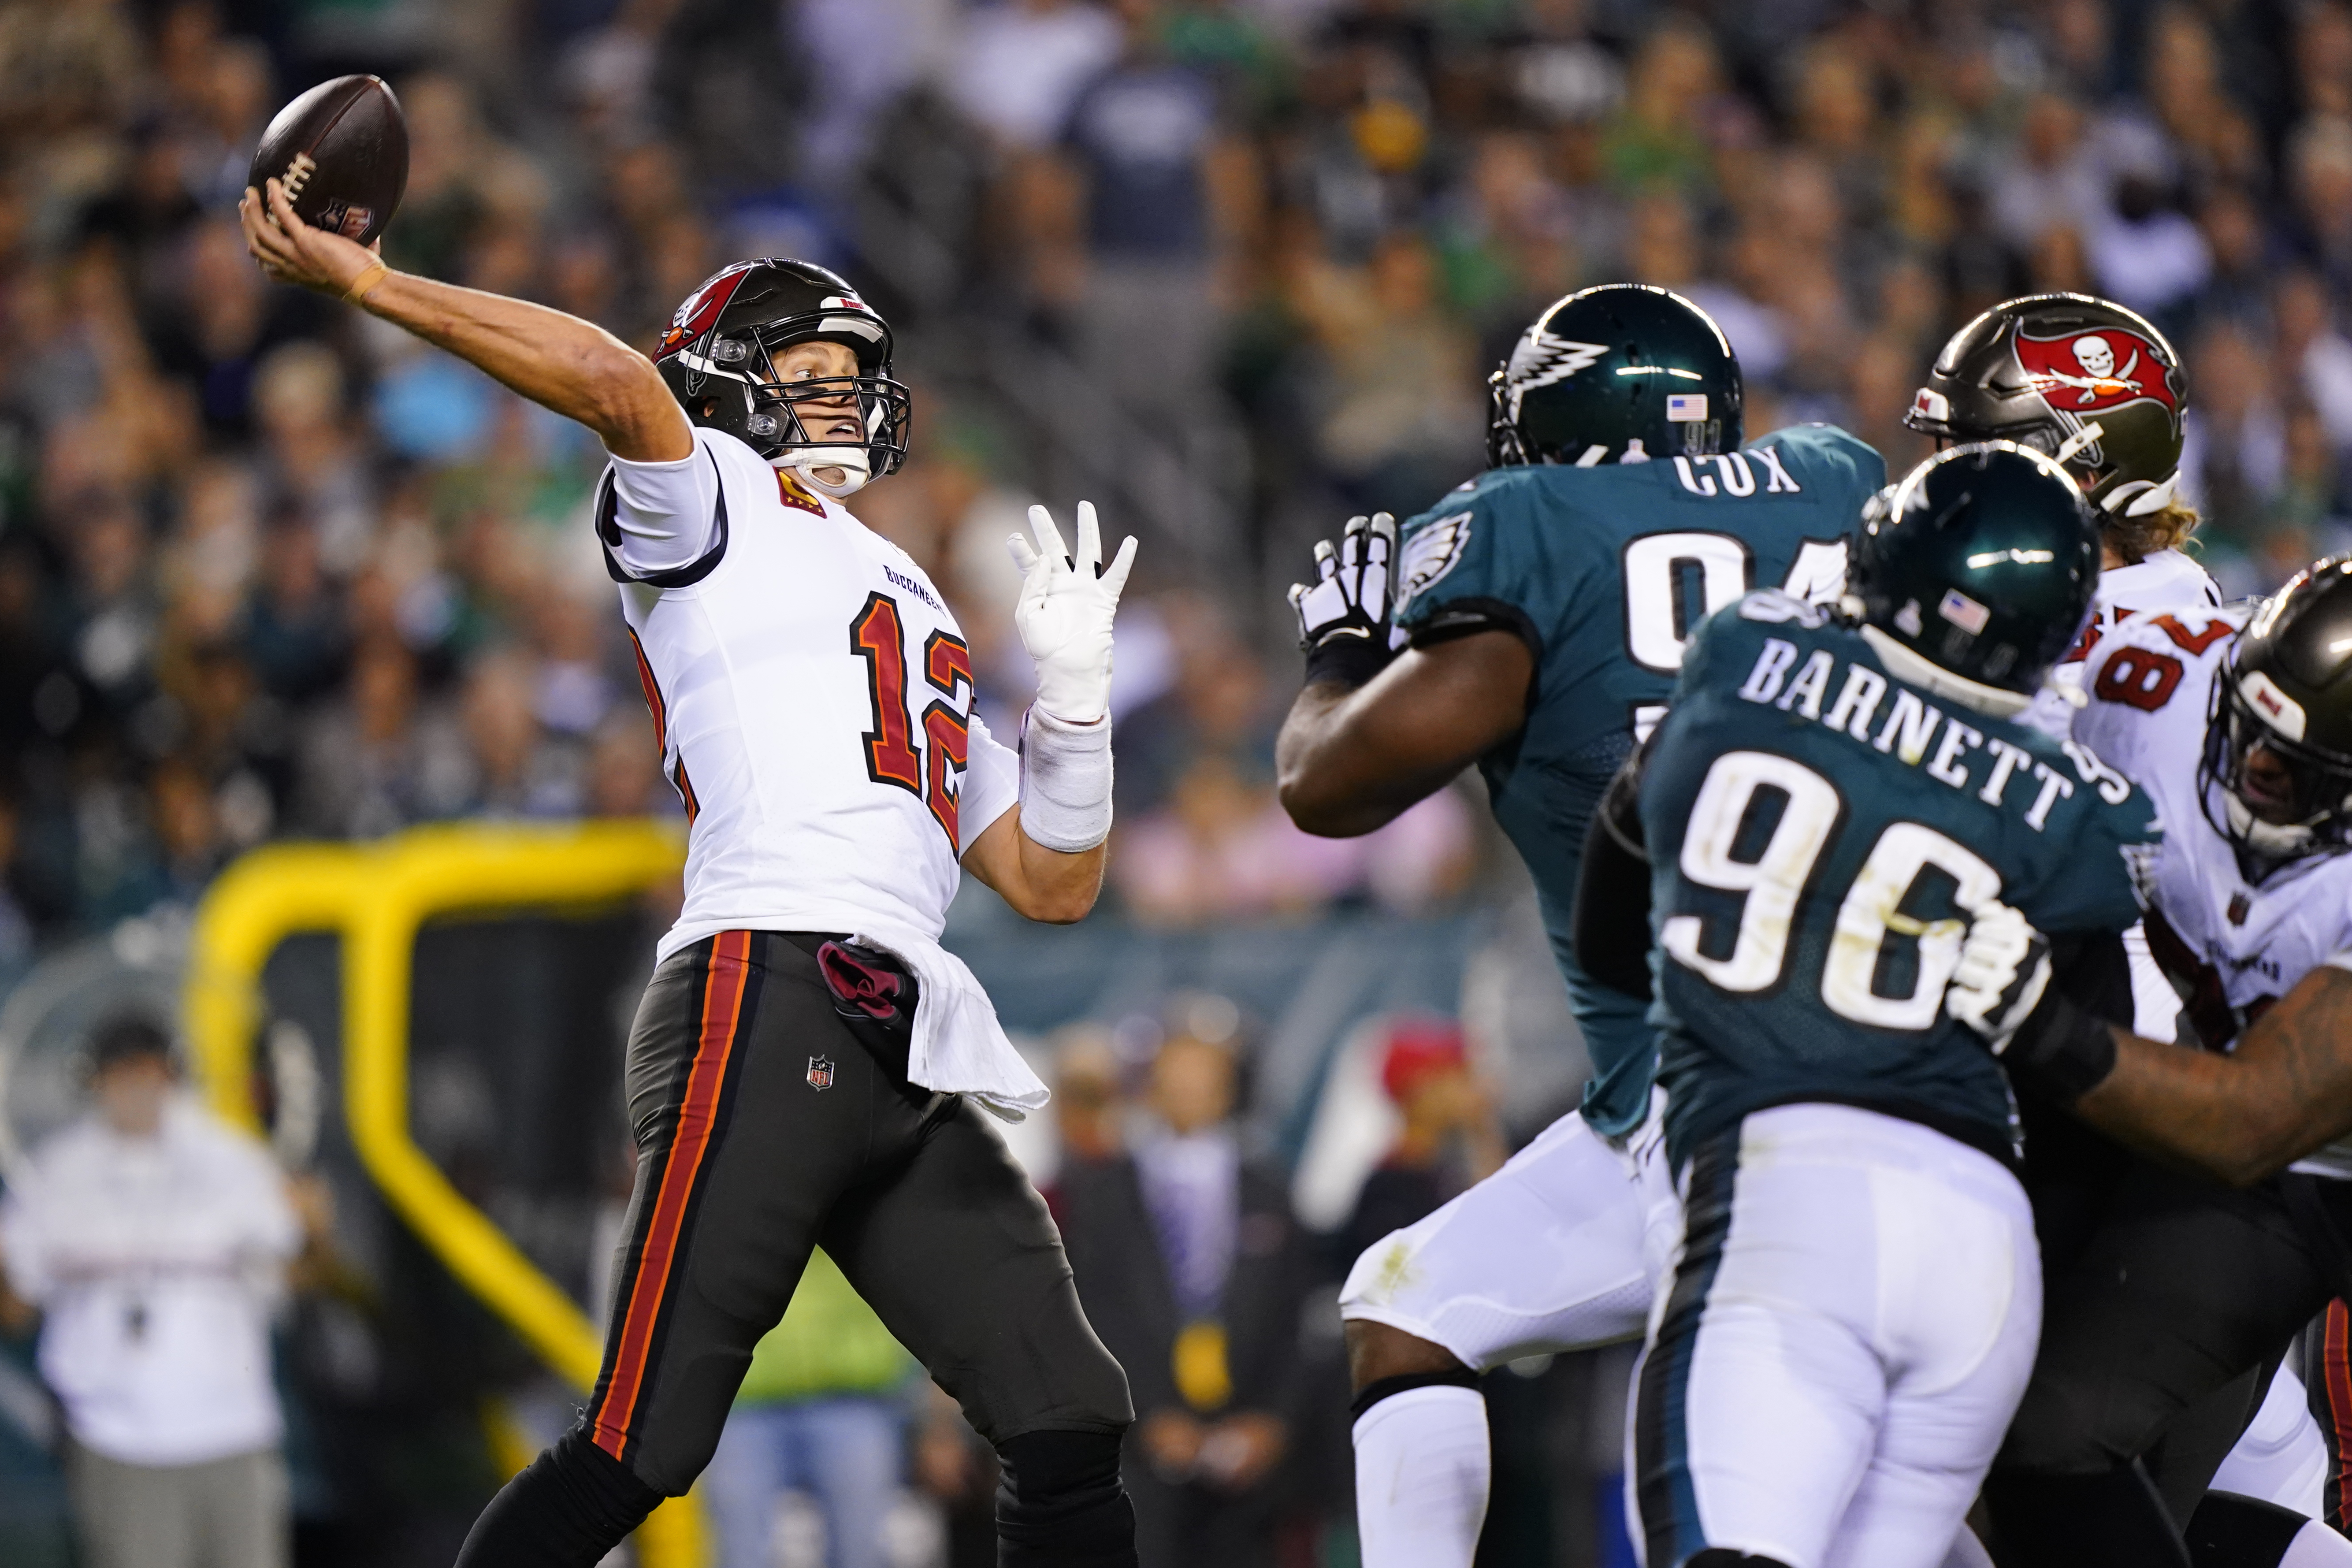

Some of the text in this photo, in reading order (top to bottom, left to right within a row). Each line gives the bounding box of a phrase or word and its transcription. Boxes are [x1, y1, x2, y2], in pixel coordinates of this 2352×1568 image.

[1673, 445, 1801, 497] COX
[849, 591, 973, 865] 12
[1738, 637, 2074, 832] BARNETT
[1660, 750, 2003, 1031] 96
